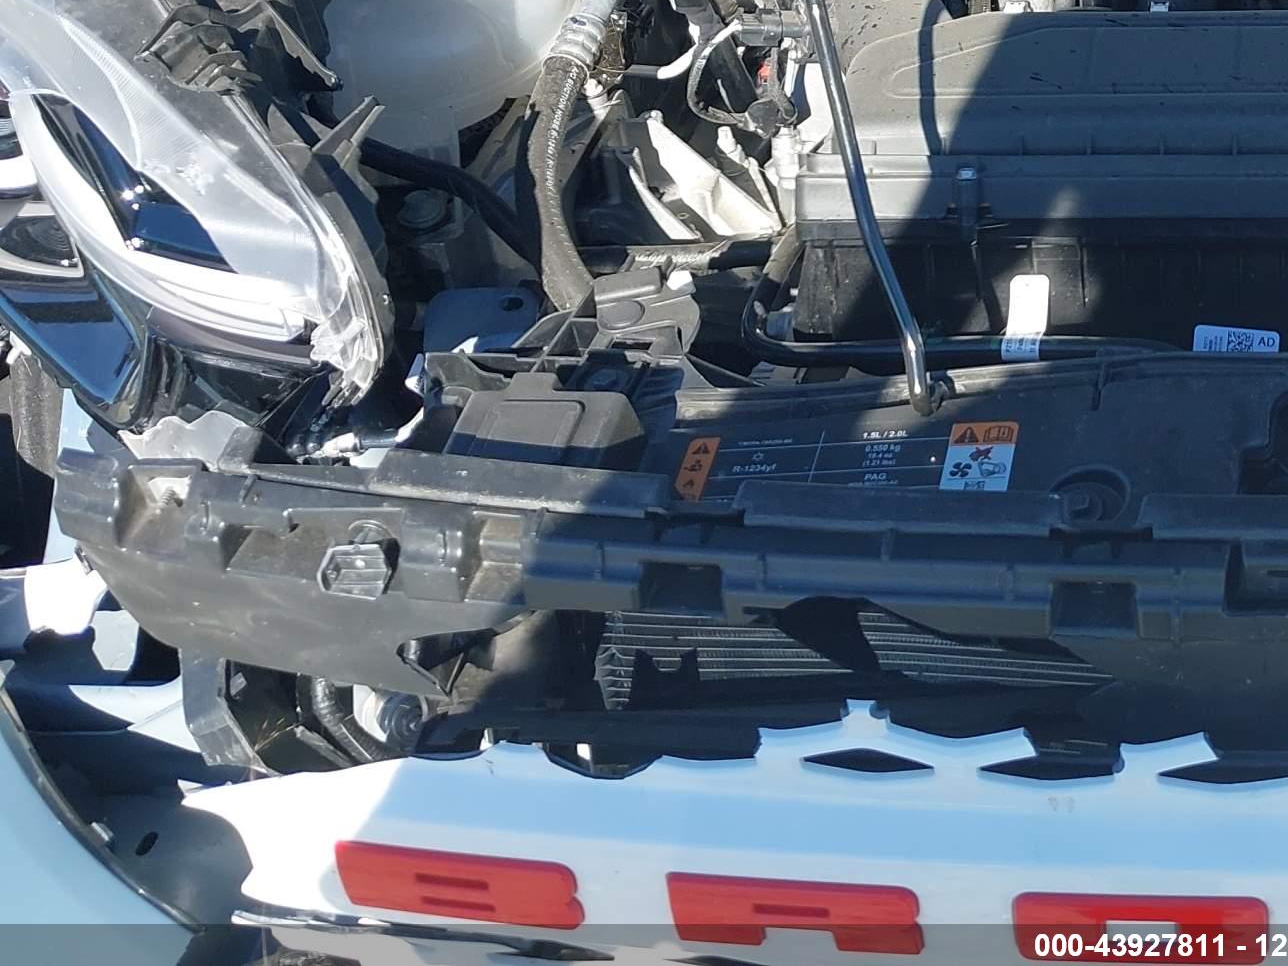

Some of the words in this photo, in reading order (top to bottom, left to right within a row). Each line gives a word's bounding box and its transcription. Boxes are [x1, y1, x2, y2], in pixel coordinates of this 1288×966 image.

[557, 78, 575, 109] SUCTION
[551, 108, 564, 130] HOSE
[1258, 336, 1275, 347] AD
[732, 463, 777, 473] R-1234yf
